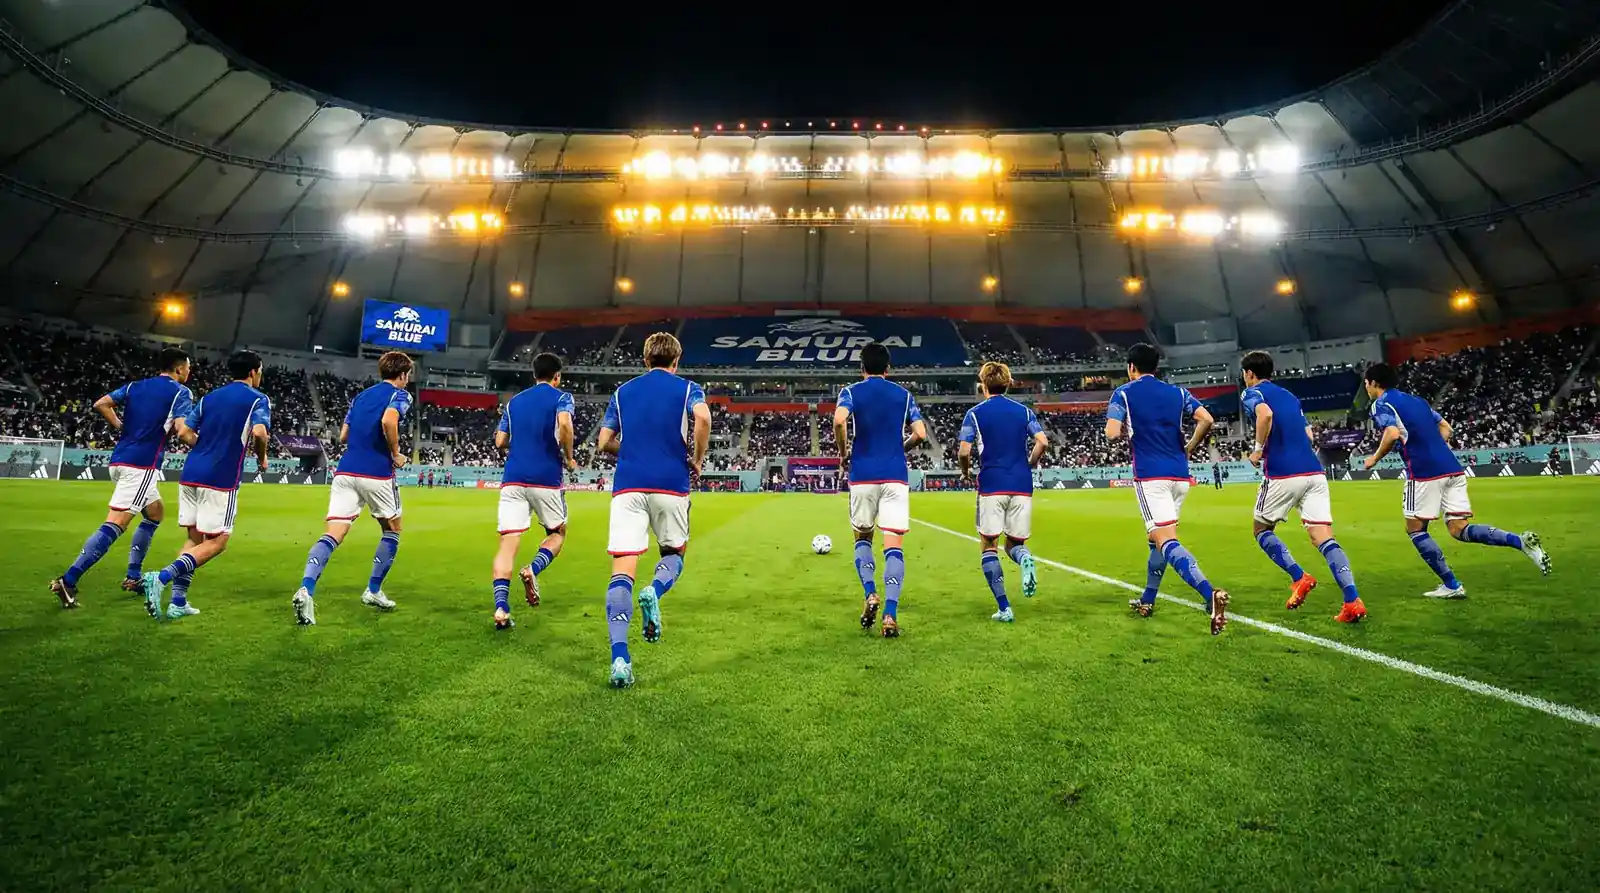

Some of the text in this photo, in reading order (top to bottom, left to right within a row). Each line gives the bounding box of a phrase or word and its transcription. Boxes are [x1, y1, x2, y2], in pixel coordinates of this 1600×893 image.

[375, 319, 436, 336] SAMURAI
[388, 331, 423, 343] BLUE
[710, 335, 922, 348] SAMURAI
